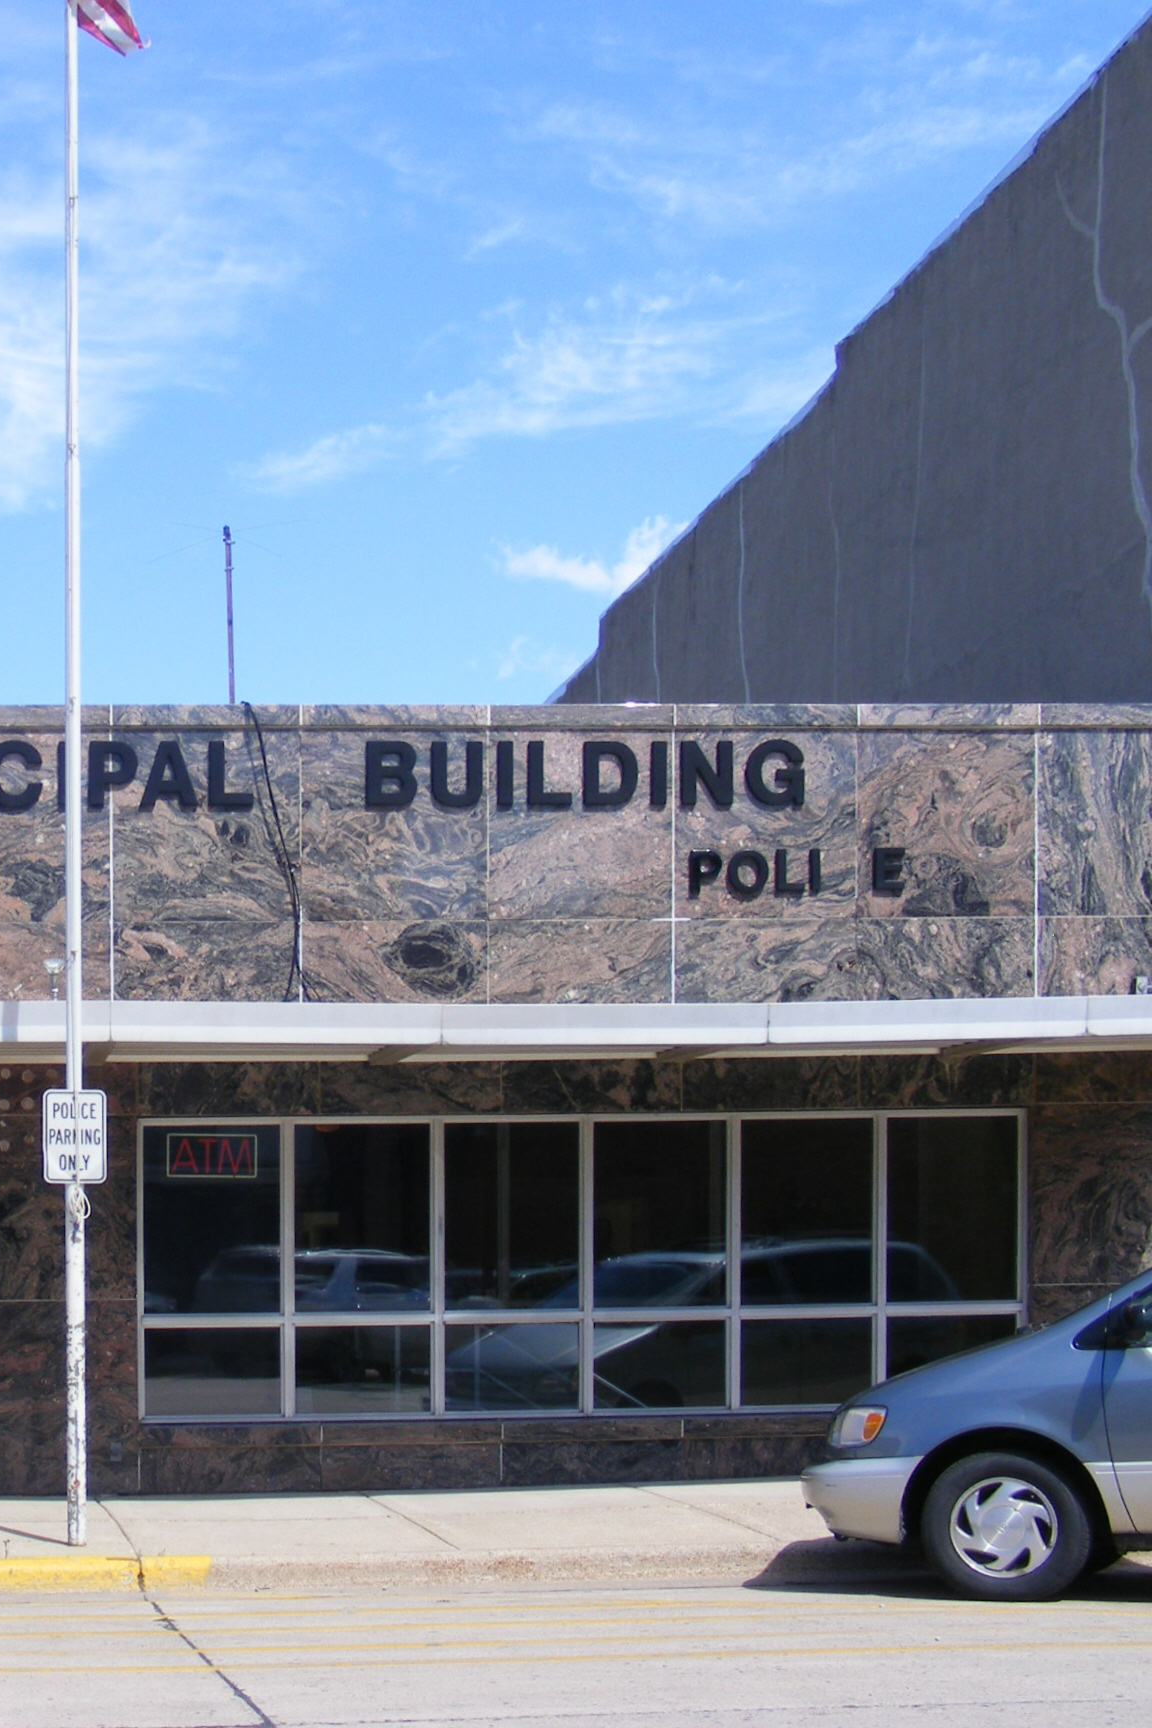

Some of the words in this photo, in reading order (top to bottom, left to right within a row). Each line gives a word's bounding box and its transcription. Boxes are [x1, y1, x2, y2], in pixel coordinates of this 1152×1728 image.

[364, 738, 805, 812] BUILDING
[52, 1102, 97, 1120] POLCE
[170, 1138, 254, 1176] ATM
